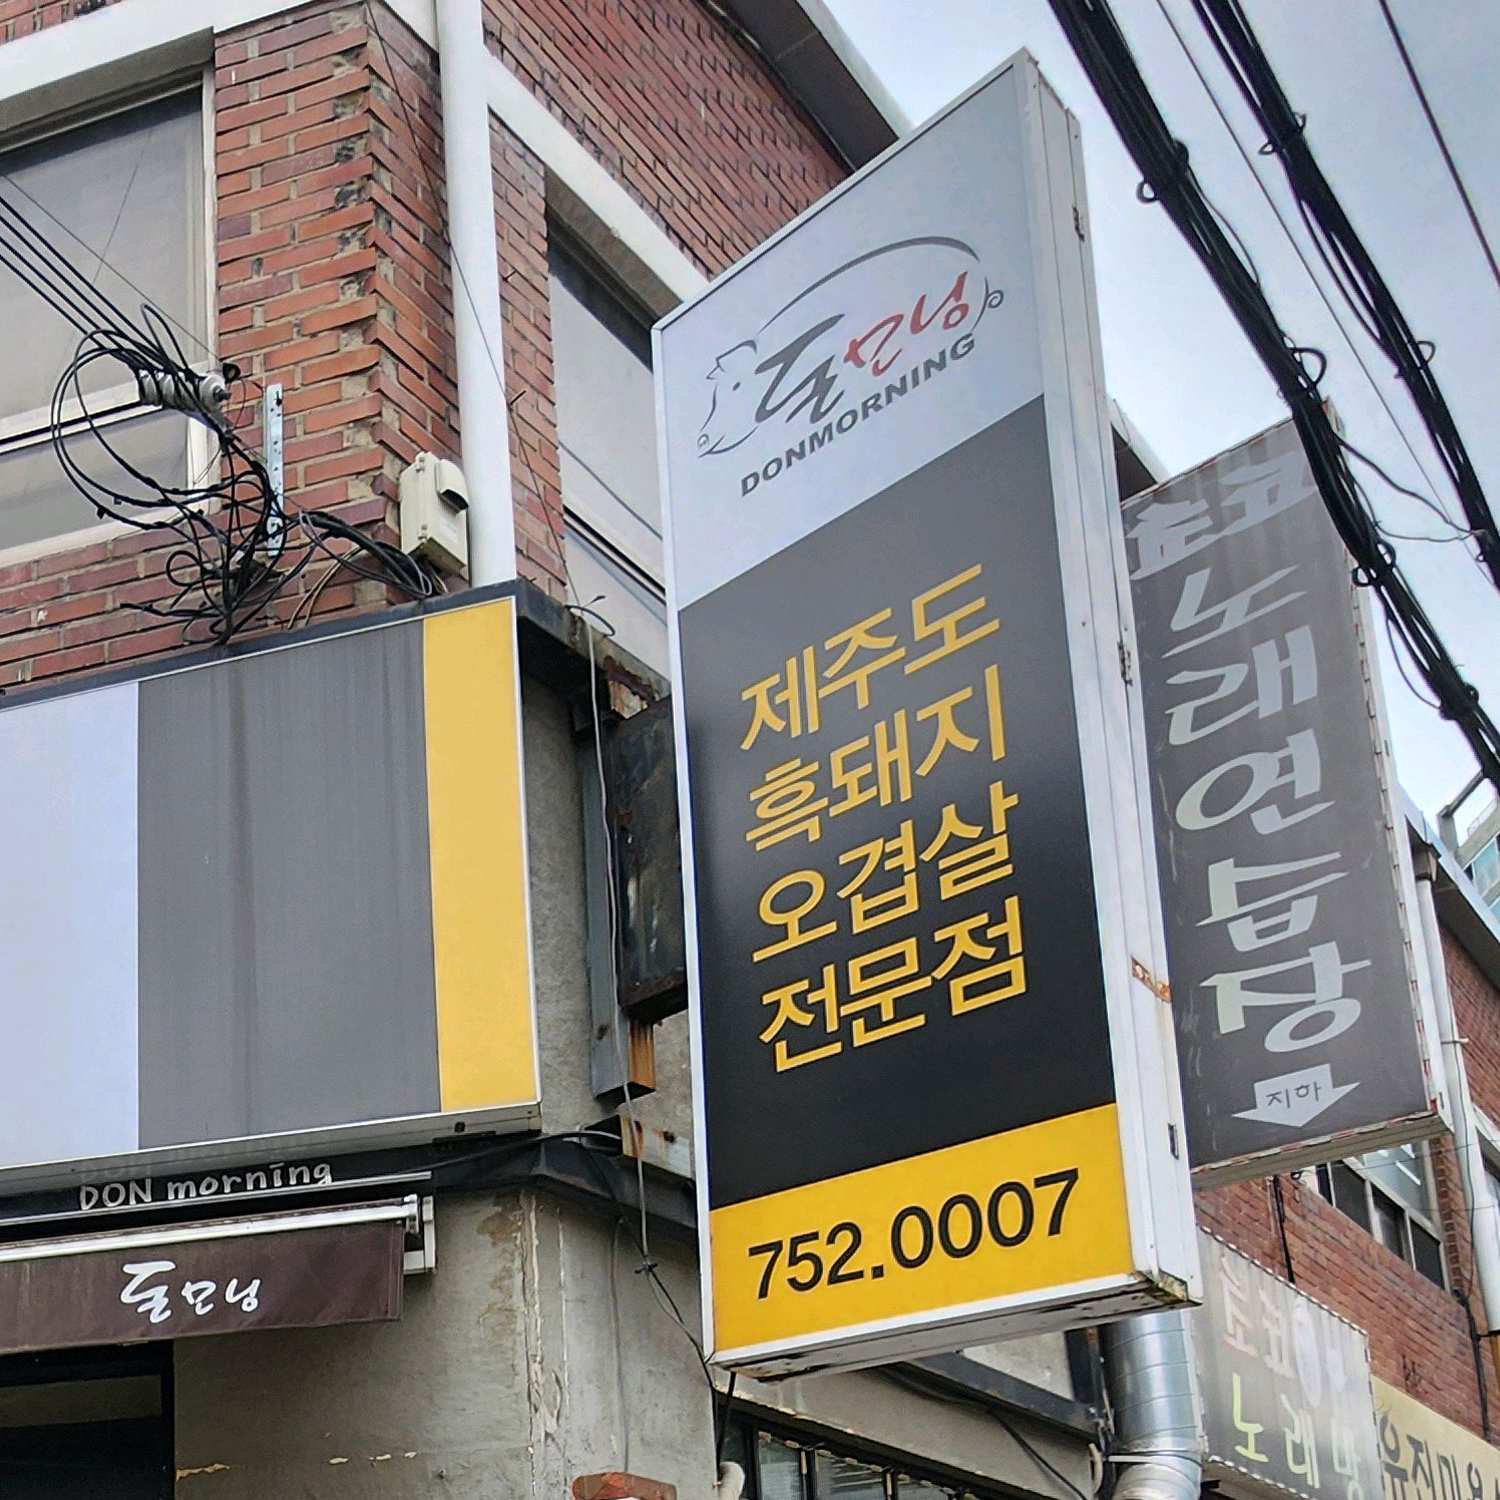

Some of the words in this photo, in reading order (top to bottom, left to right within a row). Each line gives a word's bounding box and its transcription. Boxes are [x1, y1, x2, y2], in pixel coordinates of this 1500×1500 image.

[740, 332, 976, 498] DONMORNING
[740, 563, 1001, 751] 제주도
[745, 664, 1008, 852] 흑돼지
[1160, 566, 1371, 1054] 노래연습장
[751, 781, 1019, 965] 오겹살
[759, 894, 1027, 1073] 전문점
[1265, 1080, 1322, 1110] 지하
[79, 1178, 153, 1211] DON
[748, 1168, 1080, 1301] 752.0007
